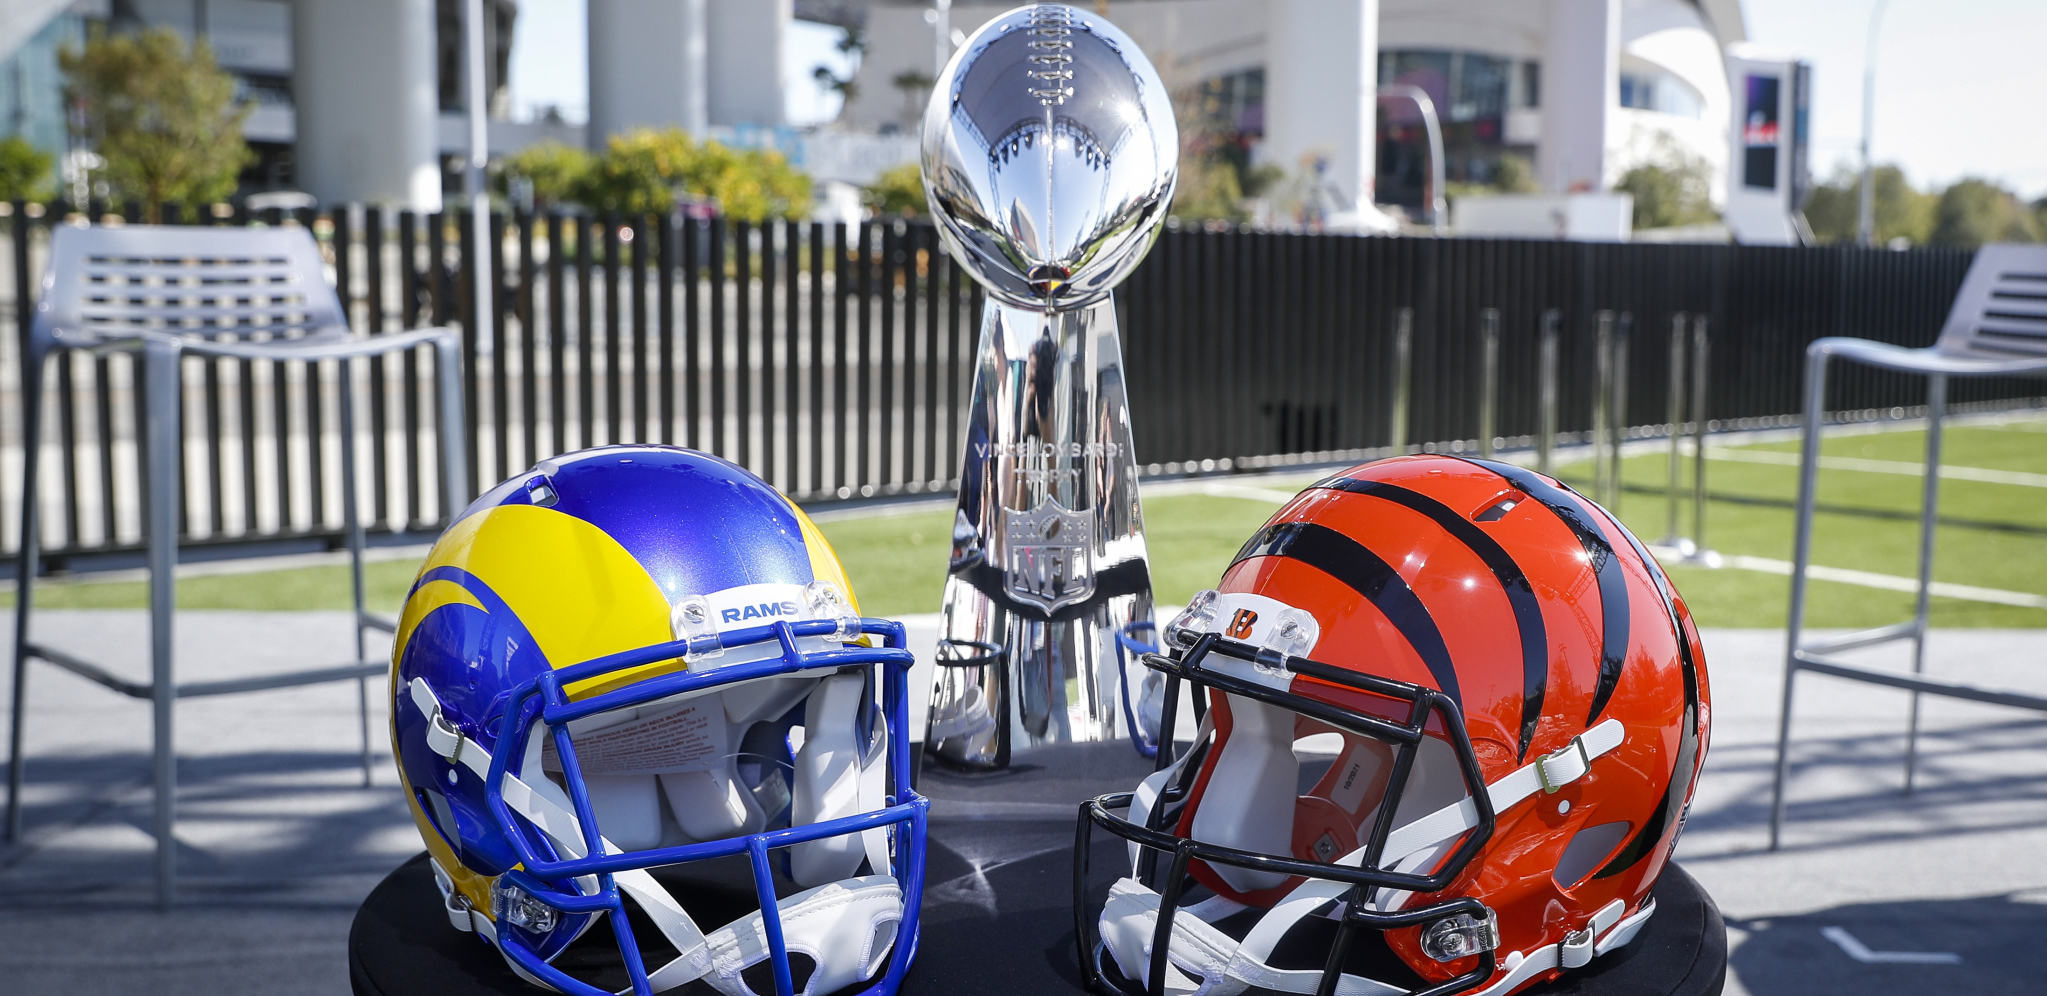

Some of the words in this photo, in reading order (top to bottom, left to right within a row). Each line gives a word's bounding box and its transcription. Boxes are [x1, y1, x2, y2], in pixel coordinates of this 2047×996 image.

[974, 442, 1028, 458] VINCE
[1012, 547, 1087, 600] NFL
[721, 601, 799, 623] RAMS
[1226, 608, 1258, 640] B
